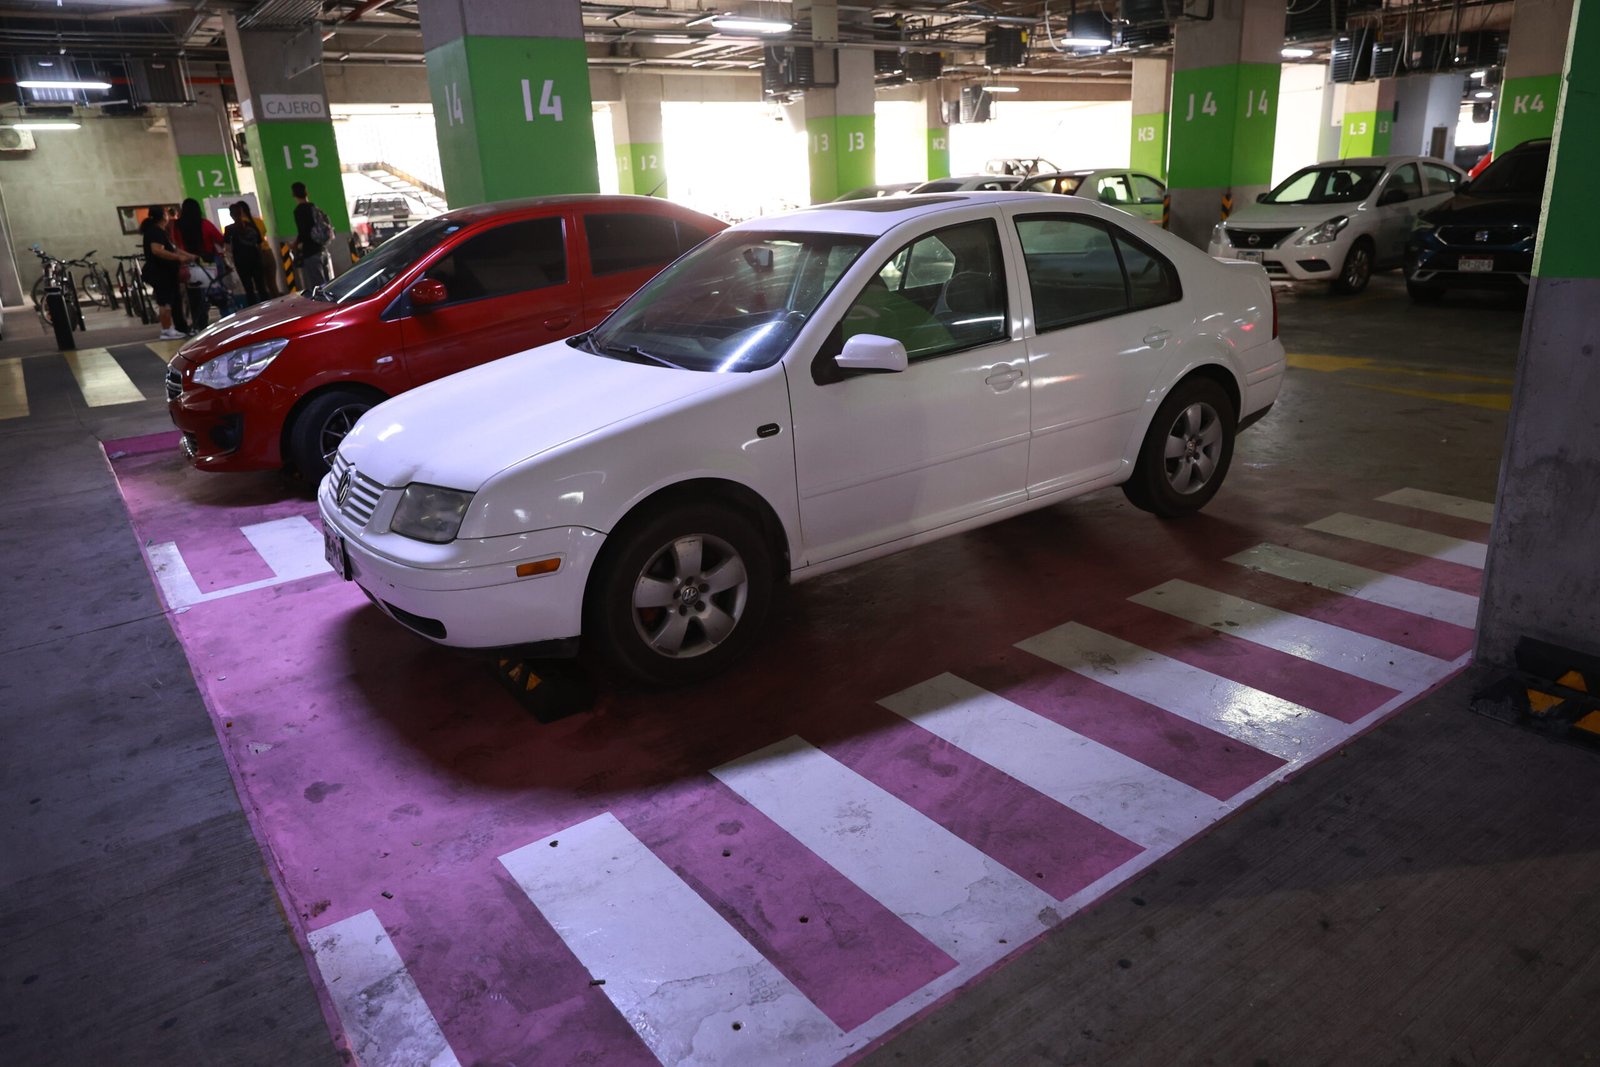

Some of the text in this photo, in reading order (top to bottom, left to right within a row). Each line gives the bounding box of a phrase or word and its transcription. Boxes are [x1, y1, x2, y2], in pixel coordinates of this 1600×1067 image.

[265, 100, 322, 115] CAJERO
[444, 82, 464, 127] I4
[521, 79, 563, 121] I4
[1185, 91, 1217, 122] J4
[1513, 93, 1545, 115] K4
[1137, 126, 1155, 143] K3
[1348, 122, 1367, 136] L3
[847, 132, 865, 153] J3
[932, 137, 946, 150] K2
